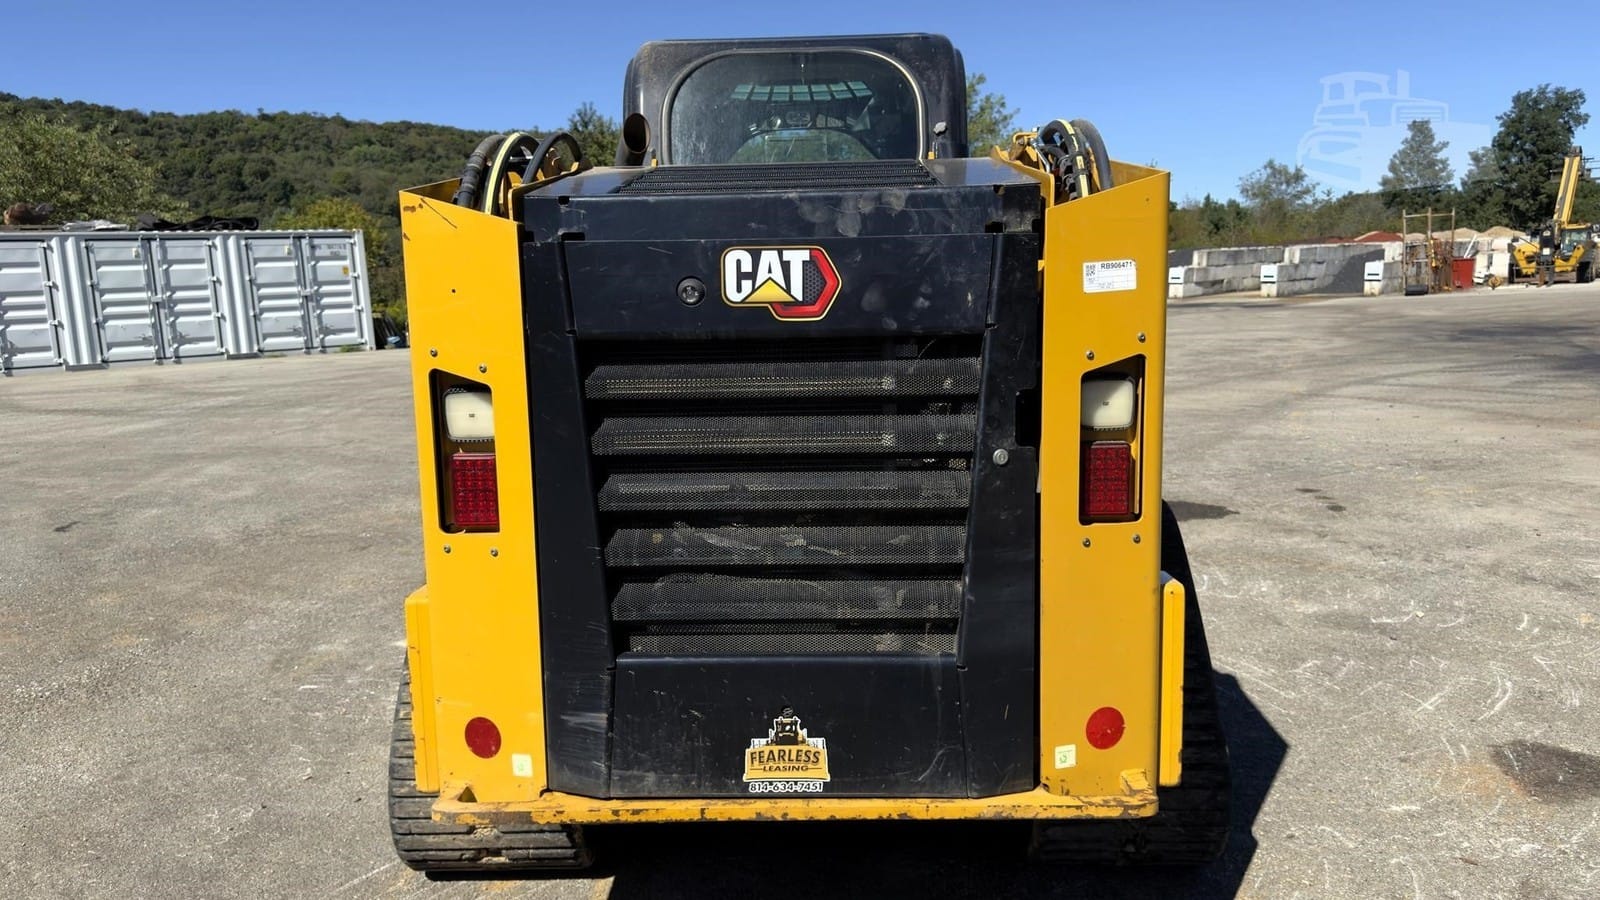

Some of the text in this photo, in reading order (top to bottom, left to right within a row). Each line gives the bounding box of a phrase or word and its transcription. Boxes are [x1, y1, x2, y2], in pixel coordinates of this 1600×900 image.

[1100, 261, 1132, 270] RB906471
[724, 249, 811, 303] CAT
[749, 748, 821, 767] FEARLESS
[762, 764, 809, 772] LEASING
[749, 782, 823, 792] 814-634-7451
